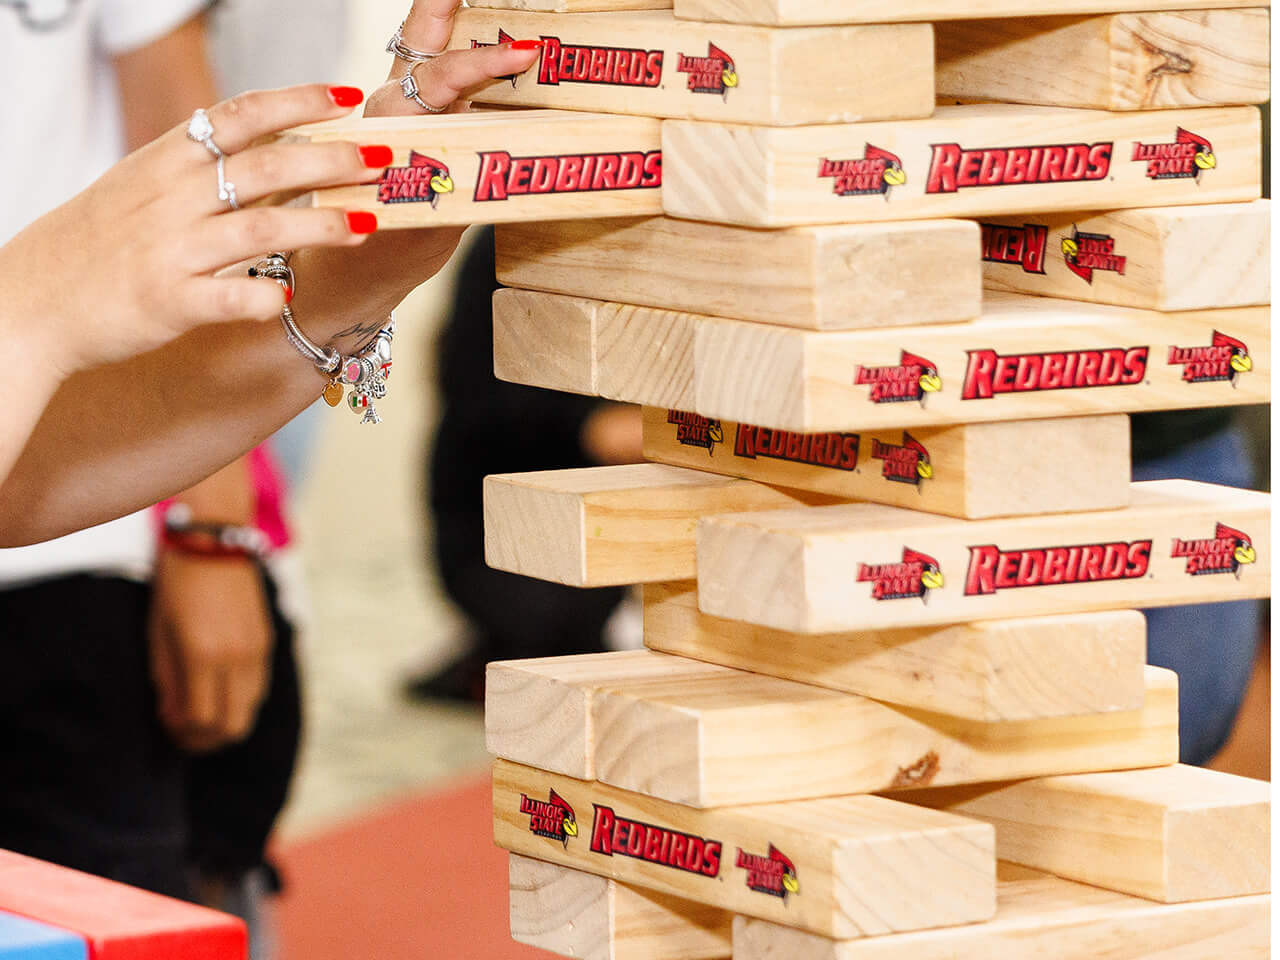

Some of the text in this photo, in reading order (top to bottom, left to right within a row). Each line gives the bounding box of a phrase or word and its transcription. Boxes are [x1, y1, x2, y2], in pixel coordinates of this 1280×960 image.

[537, 36, 664, 87] REDBIRDS
[677, 52, 723, 74] ILLINOIS
[687, 71, 722, 92] STATE
[1131, 141, 1196, 162] ILLINOIS
[473, 150, 661, 202] REDBIRDS
[817, 156, 885, 179] ILLINOIS
[925, 142, 1113, 194] REDBIRDS
[1146, 159, 1193, 178] STATE
[377, 182, 429, 201] STATE
[832, 175, 881, 195] STATE
[1167, 344, 1232, 365] ILLINOIS
[853, 364, 920, 386] ILLINOIS
[961, 346, 1149, 400] REDBIRDS
[1182, 363, 1228, 382] STATE
[867, 380, 919, 402] STATE
[667, 409, 709, 427] ILLINOIS
[677, 424, 707, 441] STATE
[734, 423, 859, 471] REDBIRDS
[871, 438, 917, 462] ILLINOIS
[882, 459, 917, 479] STATE
[1171, 537, 1235, 558] ILLINOIS
[855, 561, 921, 583] ILLINOIS
[964, 539, 1152, 596] REDBIRDS
[1186, 556, 1233, 575] STATE
[520, 793, 565, 821] ILLINOIS
[529, 814, 562, 836] STATE
[590, 803, 722, 878] REDBIRDS
